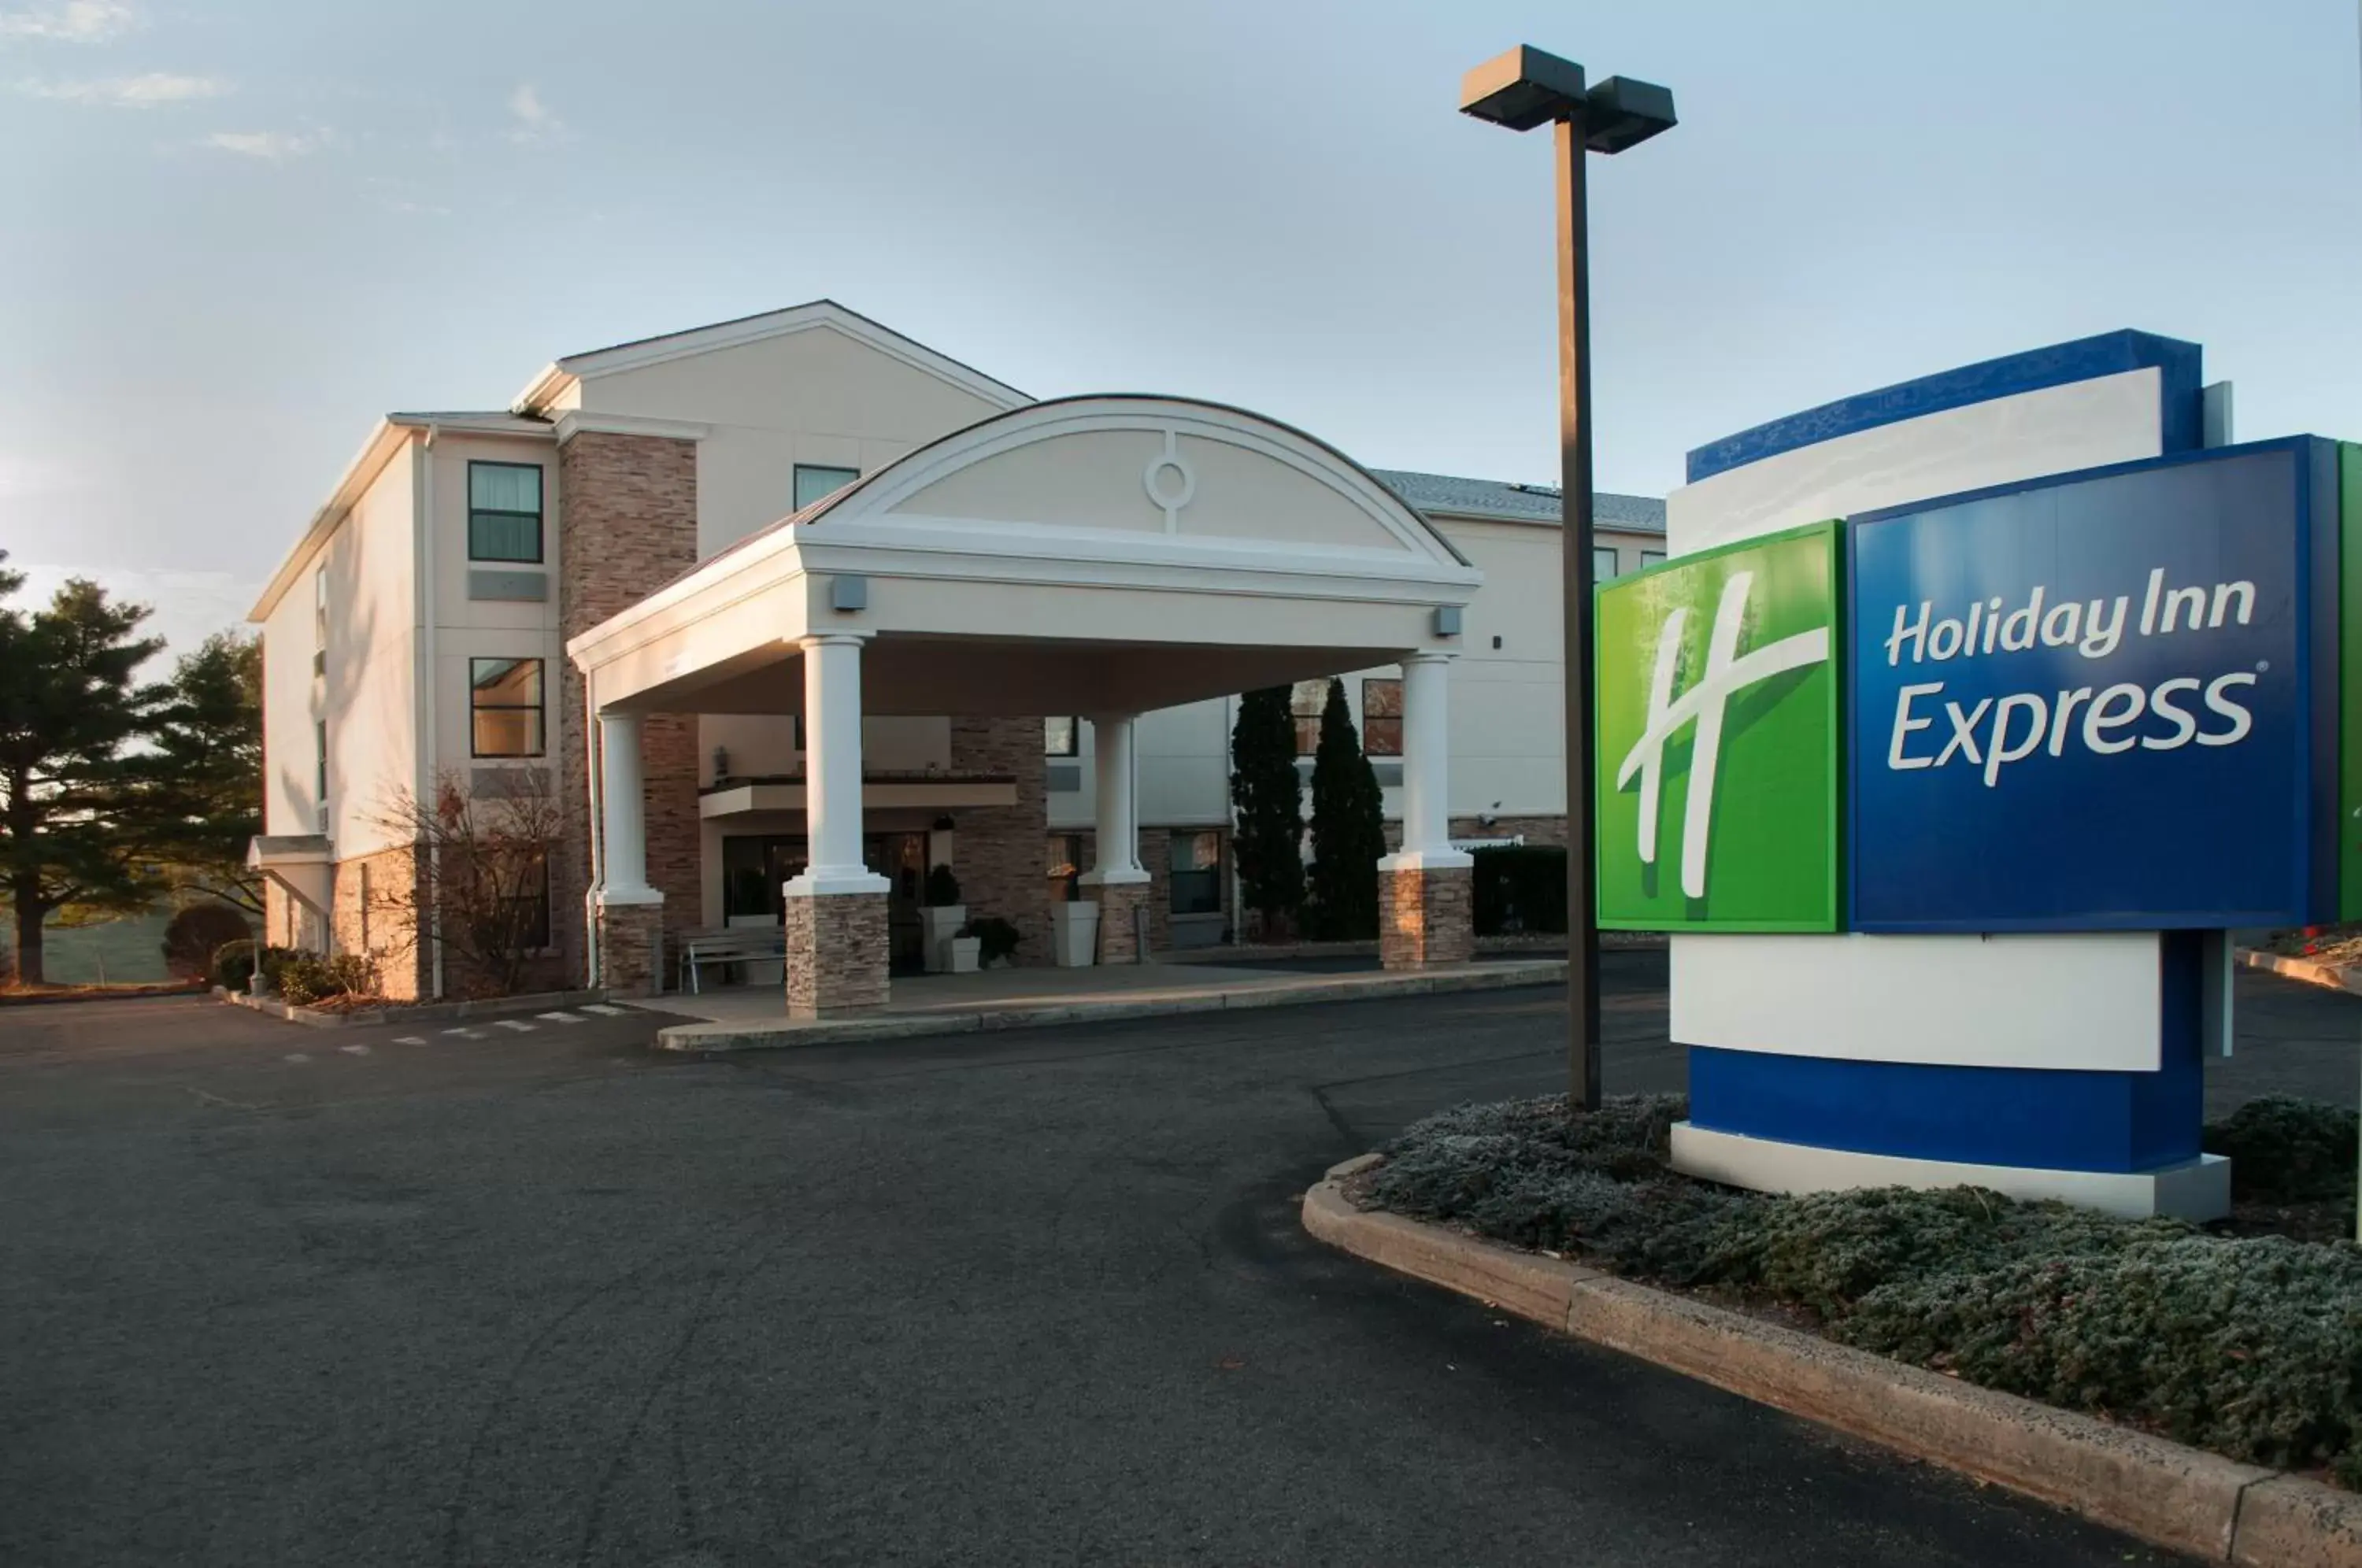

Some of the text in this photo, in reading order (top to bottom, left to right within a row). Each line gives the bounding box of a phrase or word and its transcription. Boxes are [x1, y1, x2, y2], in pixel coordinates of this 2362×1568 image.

[1885, 567, 2256, 666] Holiday Inn
[1887, 671, 2257, 787] Express
